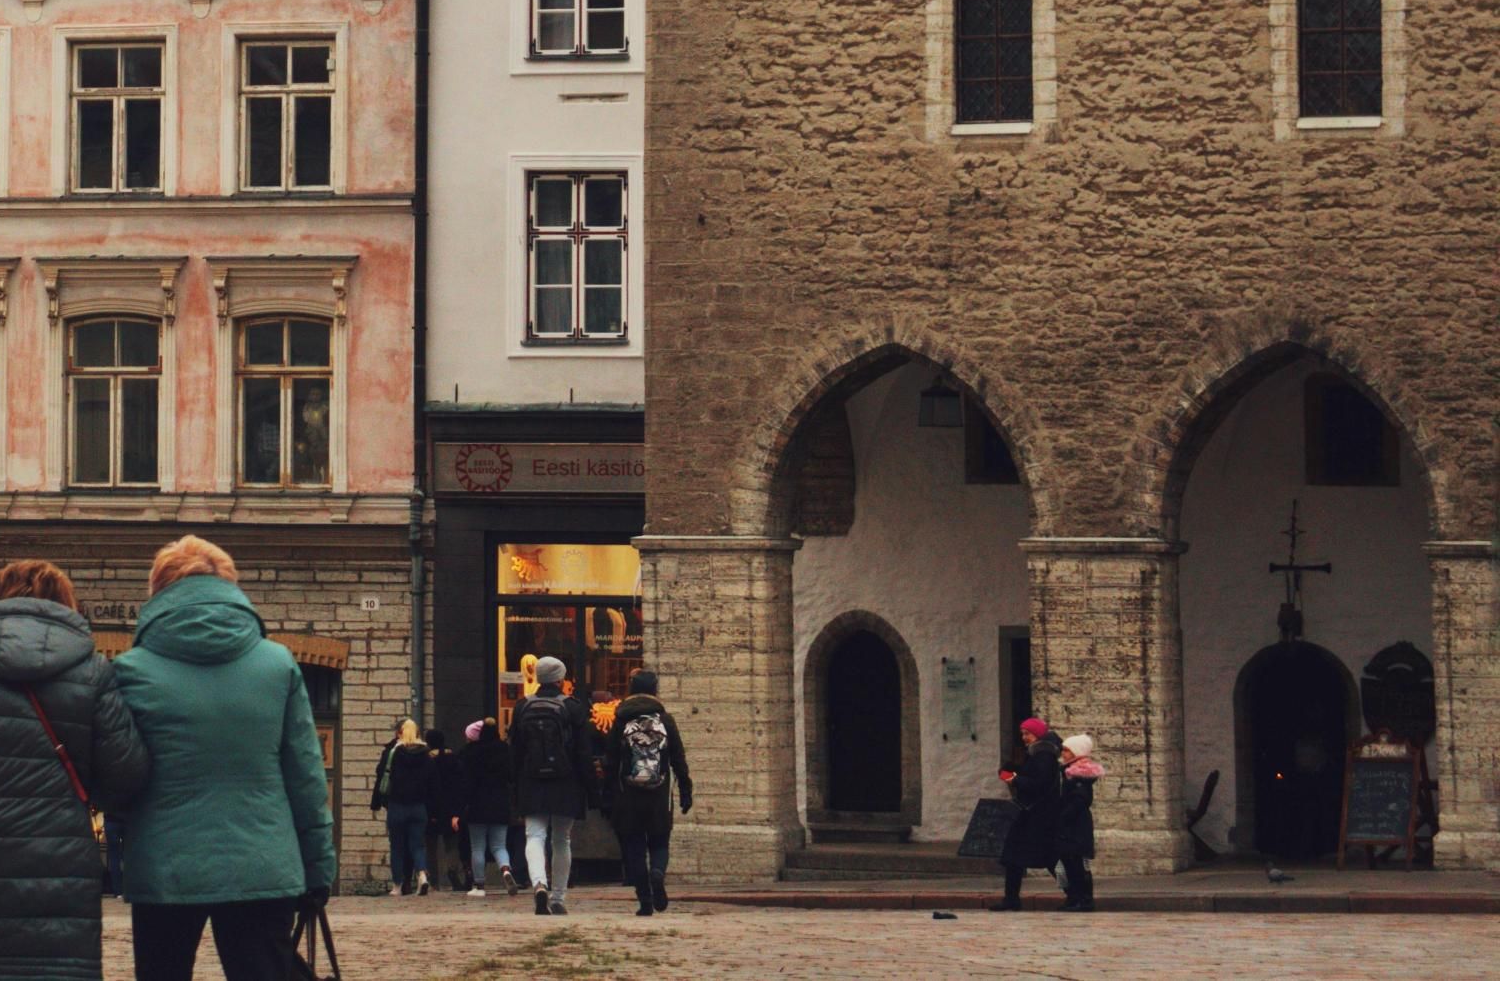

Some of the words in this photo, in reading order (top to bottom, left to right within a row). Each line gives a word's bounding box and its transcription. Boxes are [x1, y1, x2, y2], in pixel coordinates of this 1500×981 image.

[532, 458, 580, 477] Eesti
[94, 603, 125, 619] CAFÉ
[365, 600, 375, 609] 10
